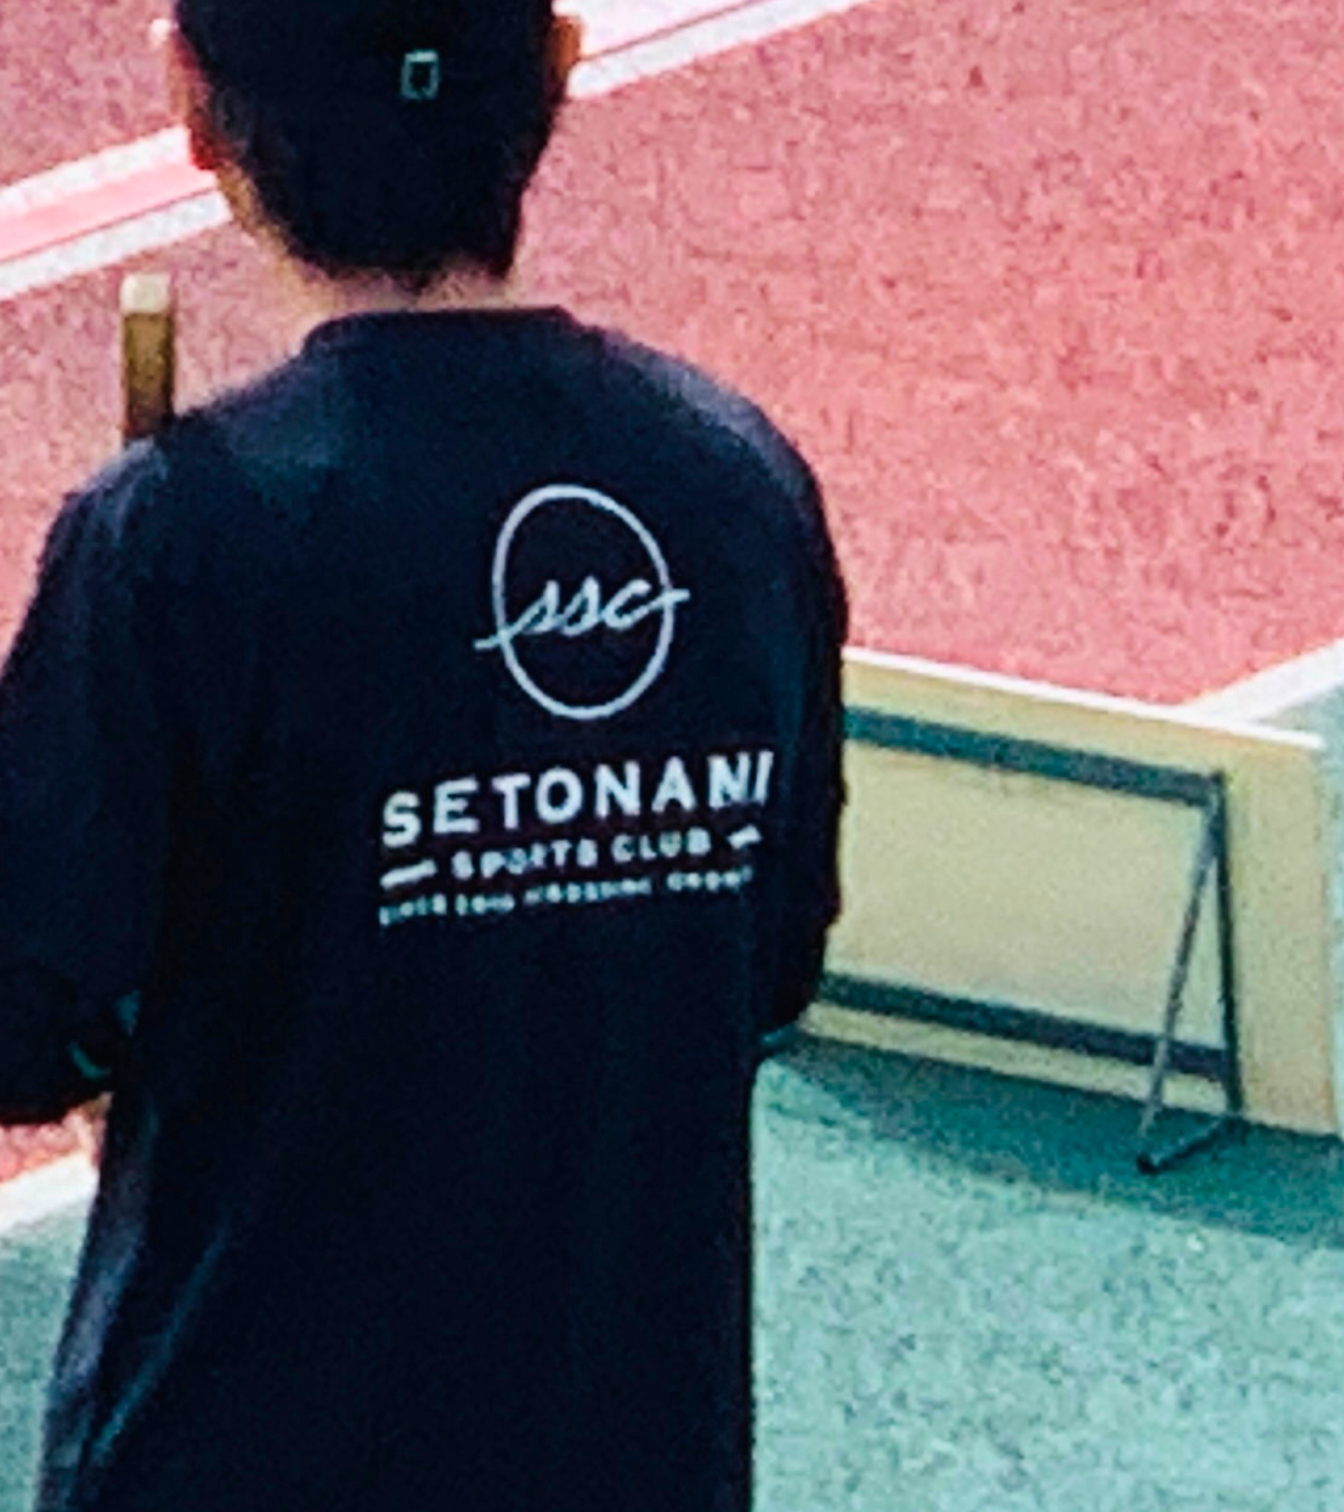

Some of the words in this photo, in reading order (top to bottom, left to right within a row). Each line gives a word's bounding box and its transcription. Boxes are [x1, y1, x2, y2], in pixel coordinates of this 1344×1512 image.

[380, 750, 775, 849] SETONANI
[451, 838, 599, 880] SPORTS
[610, 826, 711, 864] CLUB
